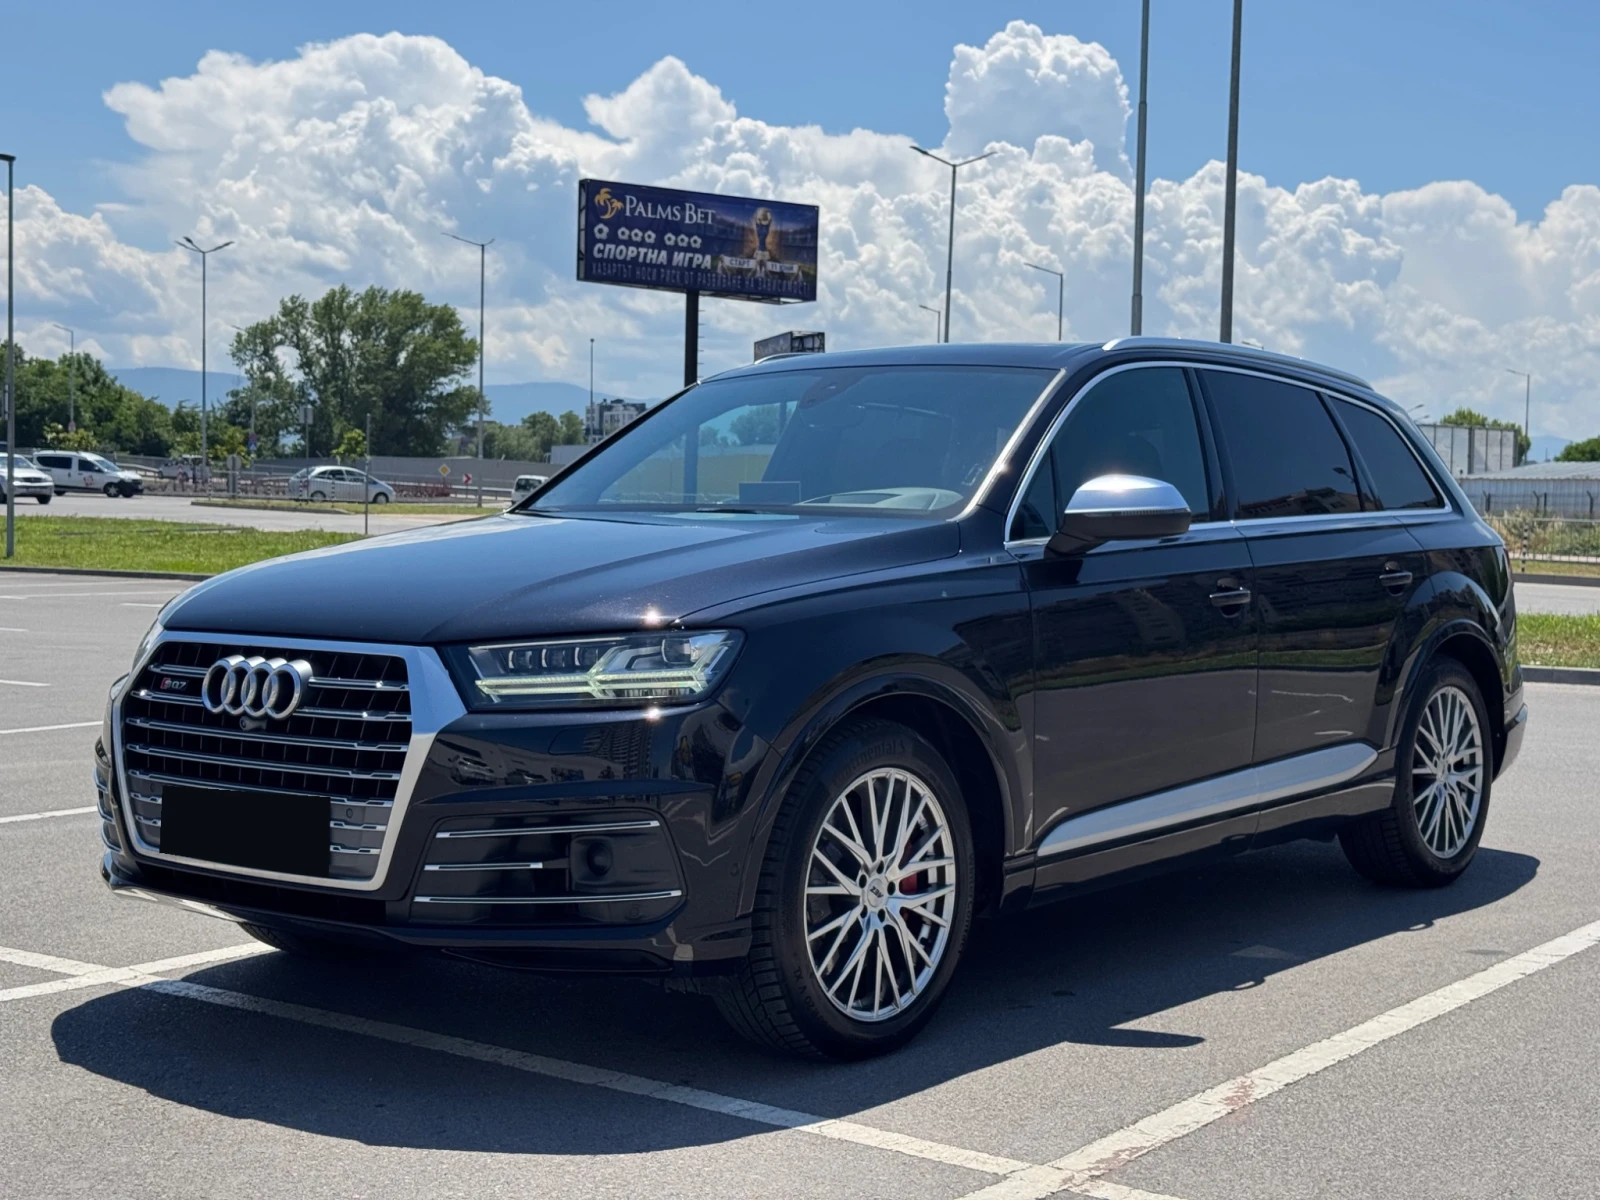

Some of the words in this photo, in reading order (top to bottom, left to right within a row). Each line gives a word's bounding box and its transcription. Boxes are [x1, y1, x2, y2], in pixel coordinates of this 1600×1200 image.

[624, 195, 681, 221] PALMS
[684, 203, 716, 224] BET
[593, 243, 668, 265] СПОРТНА
[672, 251, 711, 269] ИГРА
